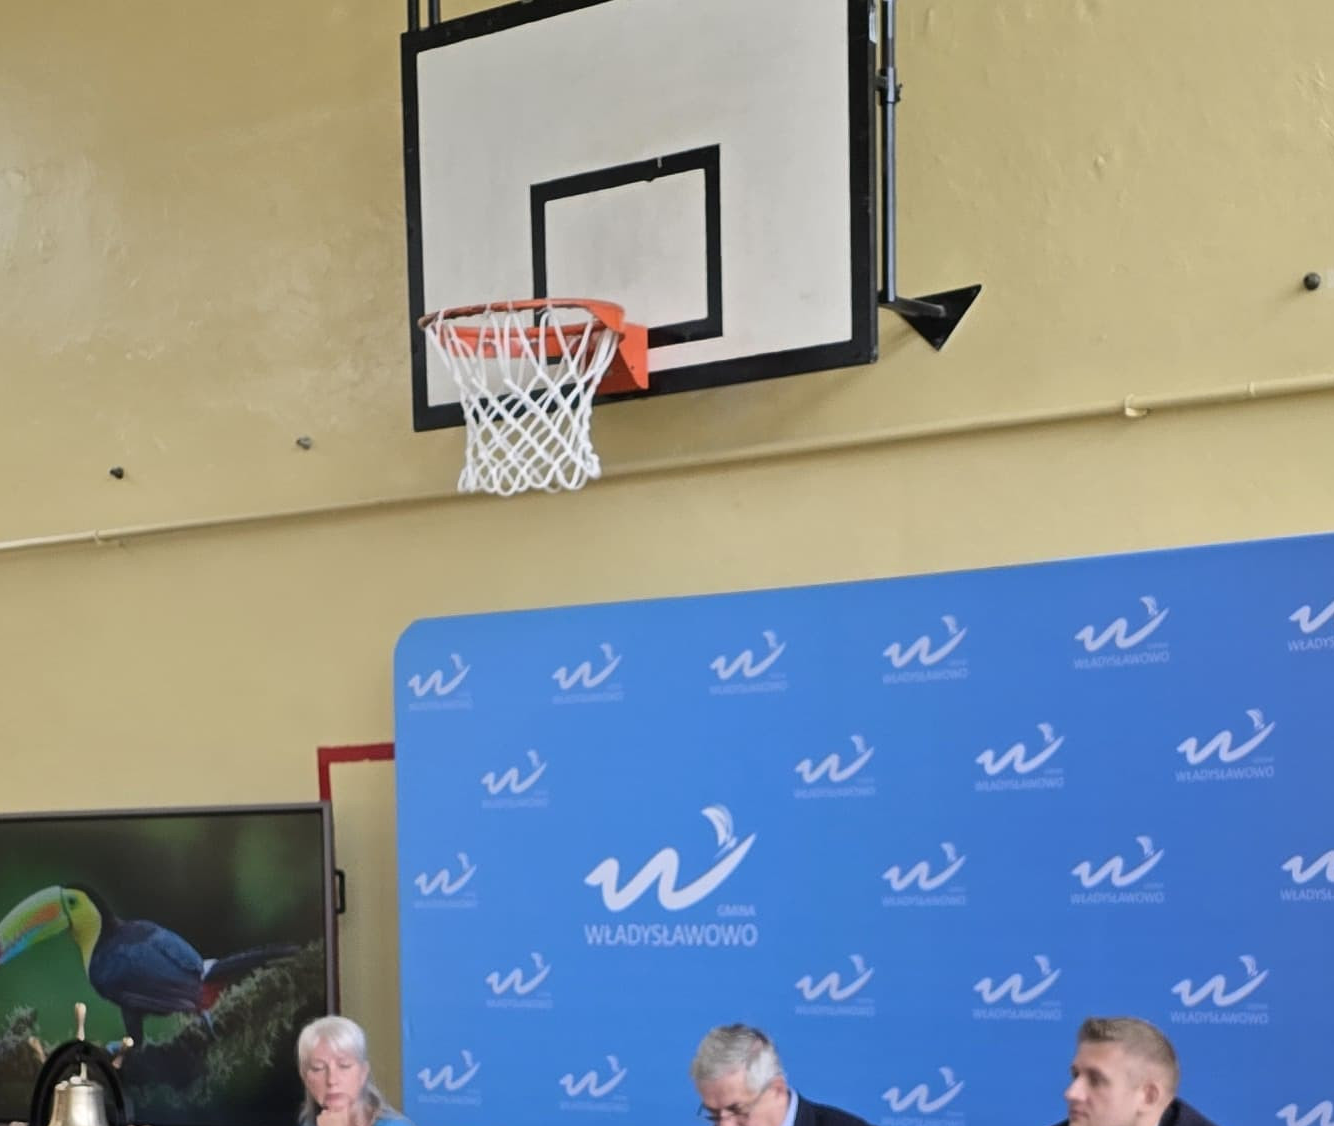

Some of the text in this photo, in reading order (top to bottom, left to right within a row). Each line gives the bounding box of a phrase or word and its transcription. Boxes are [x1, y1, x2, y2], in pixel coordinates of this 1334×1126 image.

[1074, 651, 1170, 670] WŁADYSŁAWOWO
[1175, 765, 1274, 782] WŁADYSŁAWOWO
[584, 923, 758, 946] WŁADYSŁAWOWO
